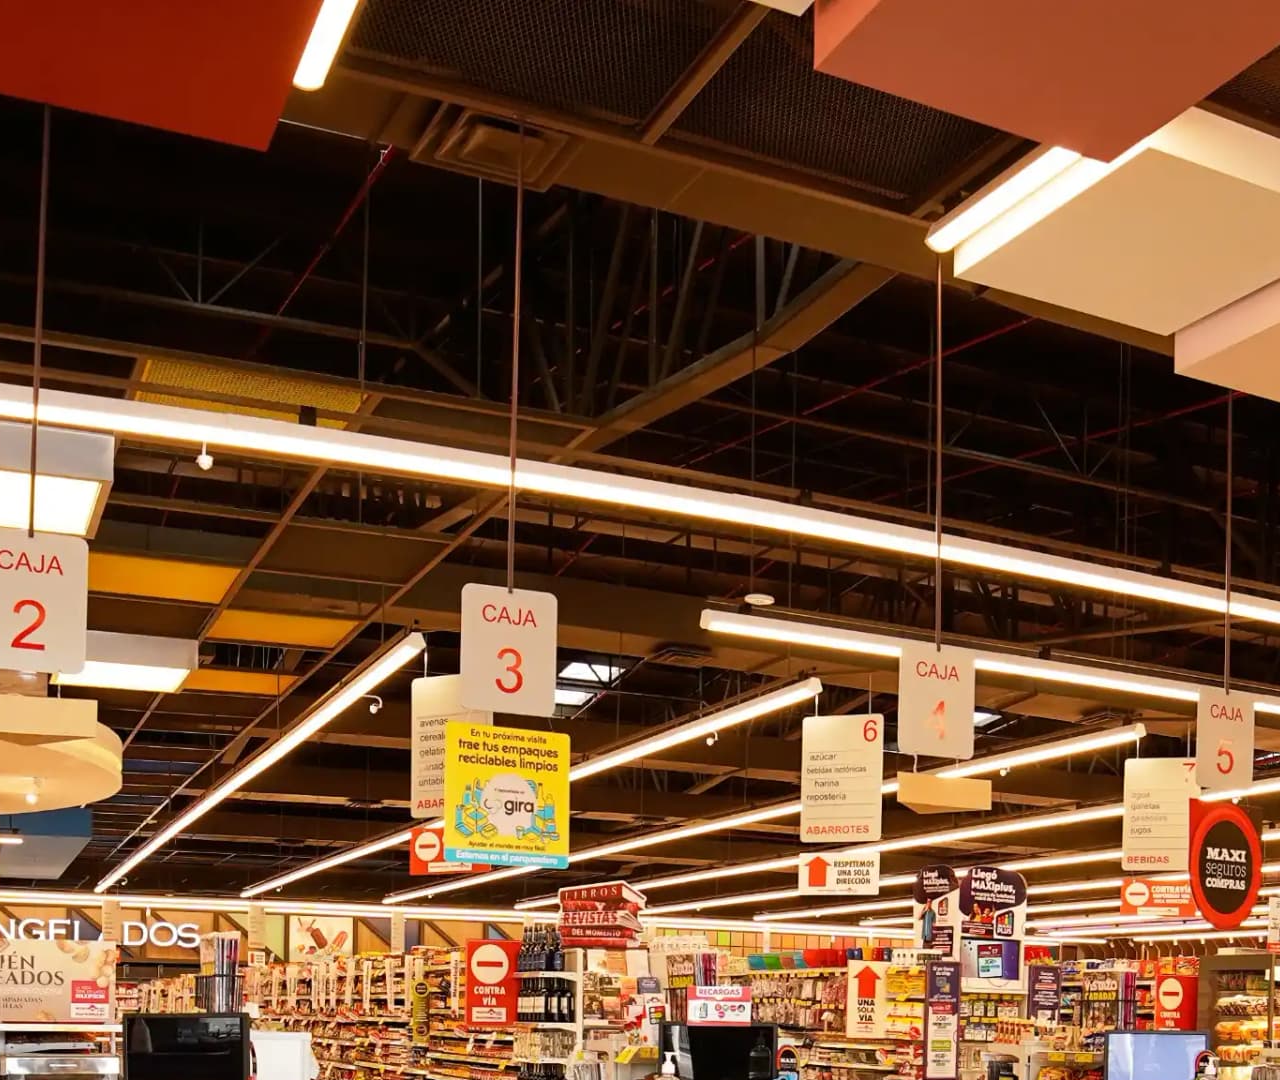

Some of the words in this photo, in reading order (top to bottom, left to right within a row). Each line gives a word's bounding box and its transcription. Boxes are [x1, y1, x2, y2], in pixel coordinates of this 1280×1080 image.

[482, 604, 537, 628] CAJA
[11, 600, 46, 650] 2
[495, 648, 523, 694] 3
[916, 661, 960, 681] CAJA
[1210, 703, 1243, 722] CAJA
[471, 728, 481, 737] En
[483, 730, 491, 738] tu
[493, 731, 525, 743] próxima
[527, 734, 547, 744] visita
[863, 720, 878, 742] 6
[459, 738, 480, 750] trae
[482, 740, 499, 752] tus
[501, 744, 558, 758] empaques
[458, 753, 517, 768] reciclables
[520, 755, 558, 772] limpios
[1216, 739, 1234, 775] 5
[504, 798, 535, 815] gira
[807, 825, 869, 835] ABARROTES
[1127, 855, 1169, 864] BEBIDAS
[1206, 847, 1246, 862] MAXI
[837, 869, 851, 877] UNA
[972, 869, 998, 883] Llegó
[1205, 862, 1246, 878] seguros
[1205, 877, 1246, 890] COMPRAS
[565, 886, 618, 900] LIBROS
[564, 910, 618, 926] REVISTAS
[572, 928, 585, 936] DEL
[585, 929, 621, 937] MOMENTO
[474, 985, 506, 995] CONTRA
[698, 988, 741, 996] RECARGAS
